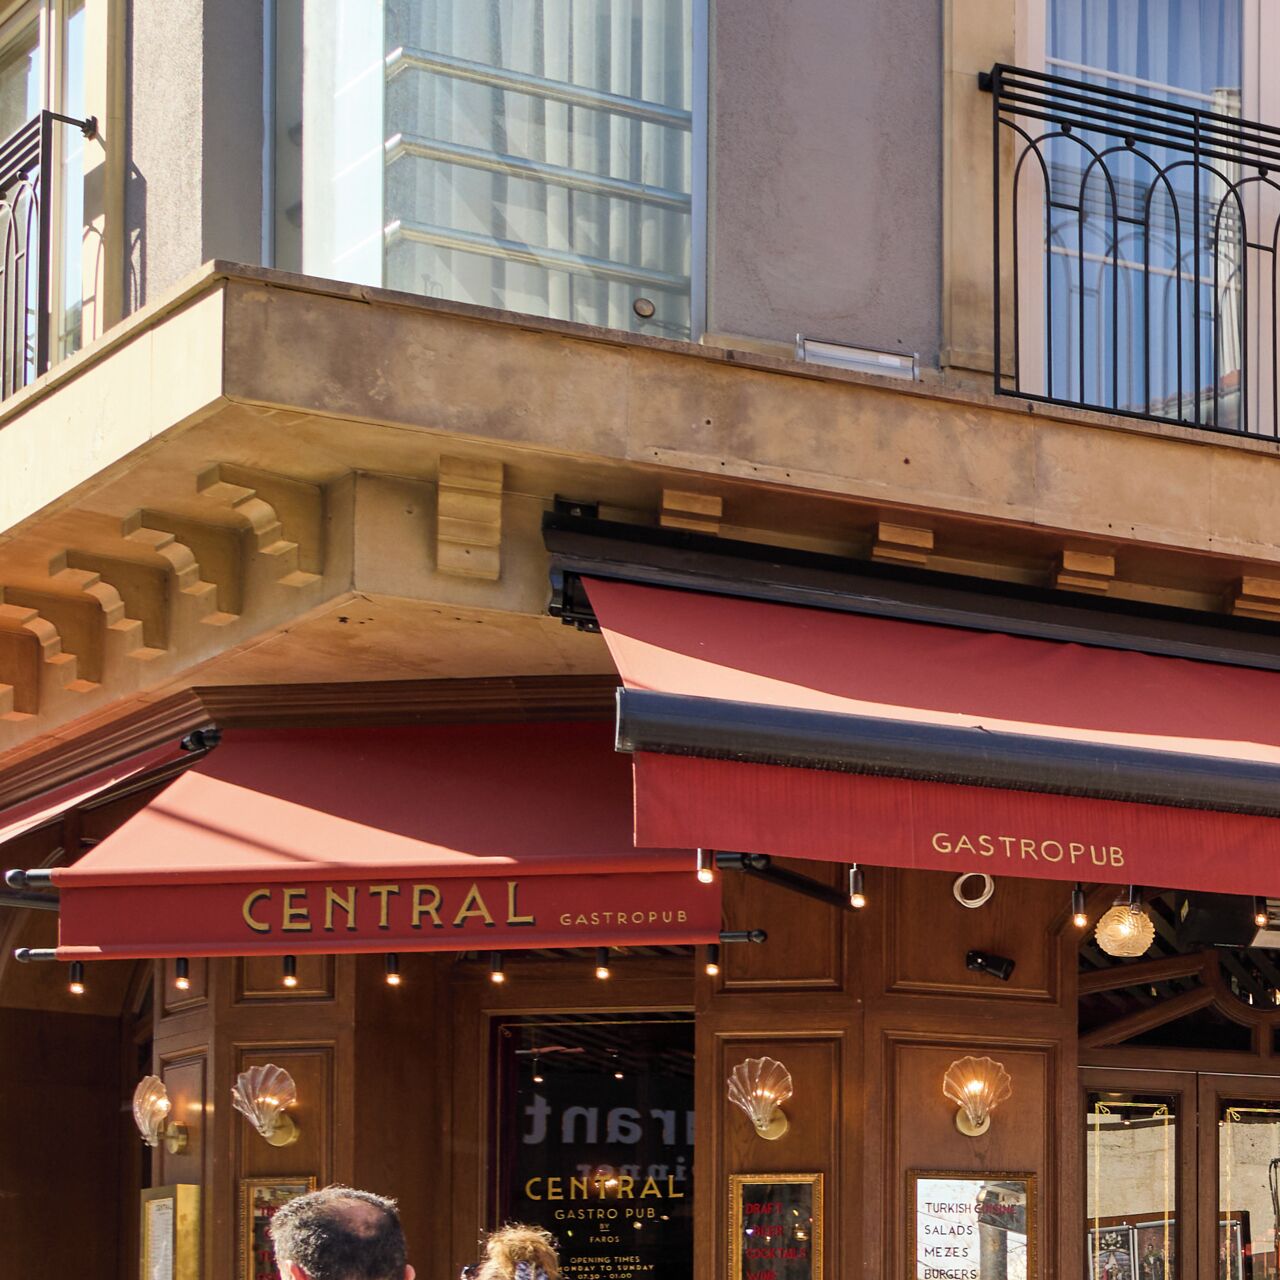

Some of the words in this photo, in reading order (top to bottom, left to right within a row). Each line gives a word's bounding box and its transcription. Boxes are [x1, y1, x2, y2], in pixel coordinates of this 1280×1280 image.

[931, 832, 1125, 867] GASTROPUB
[242, 881, 536, 932] CENTRAL
[559, 910, 688, 927] GASTROPUB
[525, 1174, 685, 1200] CENTRAL
[554, 1208, 618, 1220] GASTRO
[625, 1207, 656, 1219] PUB
[745, 1202, 783, 1215] DRAFT
[925, 1202, 972, 1214] TURKISH
[924, 1225, 973, 1236] SALADS
[589, 1235, 620, 1243] FAROS
[924, 1247, 969, 1258] MEZES
[570, 1256, 611, 1264] OPENING
[600, 1264, 612, 1272] TO
[924, 1269, 977, 1280] BURGERS
